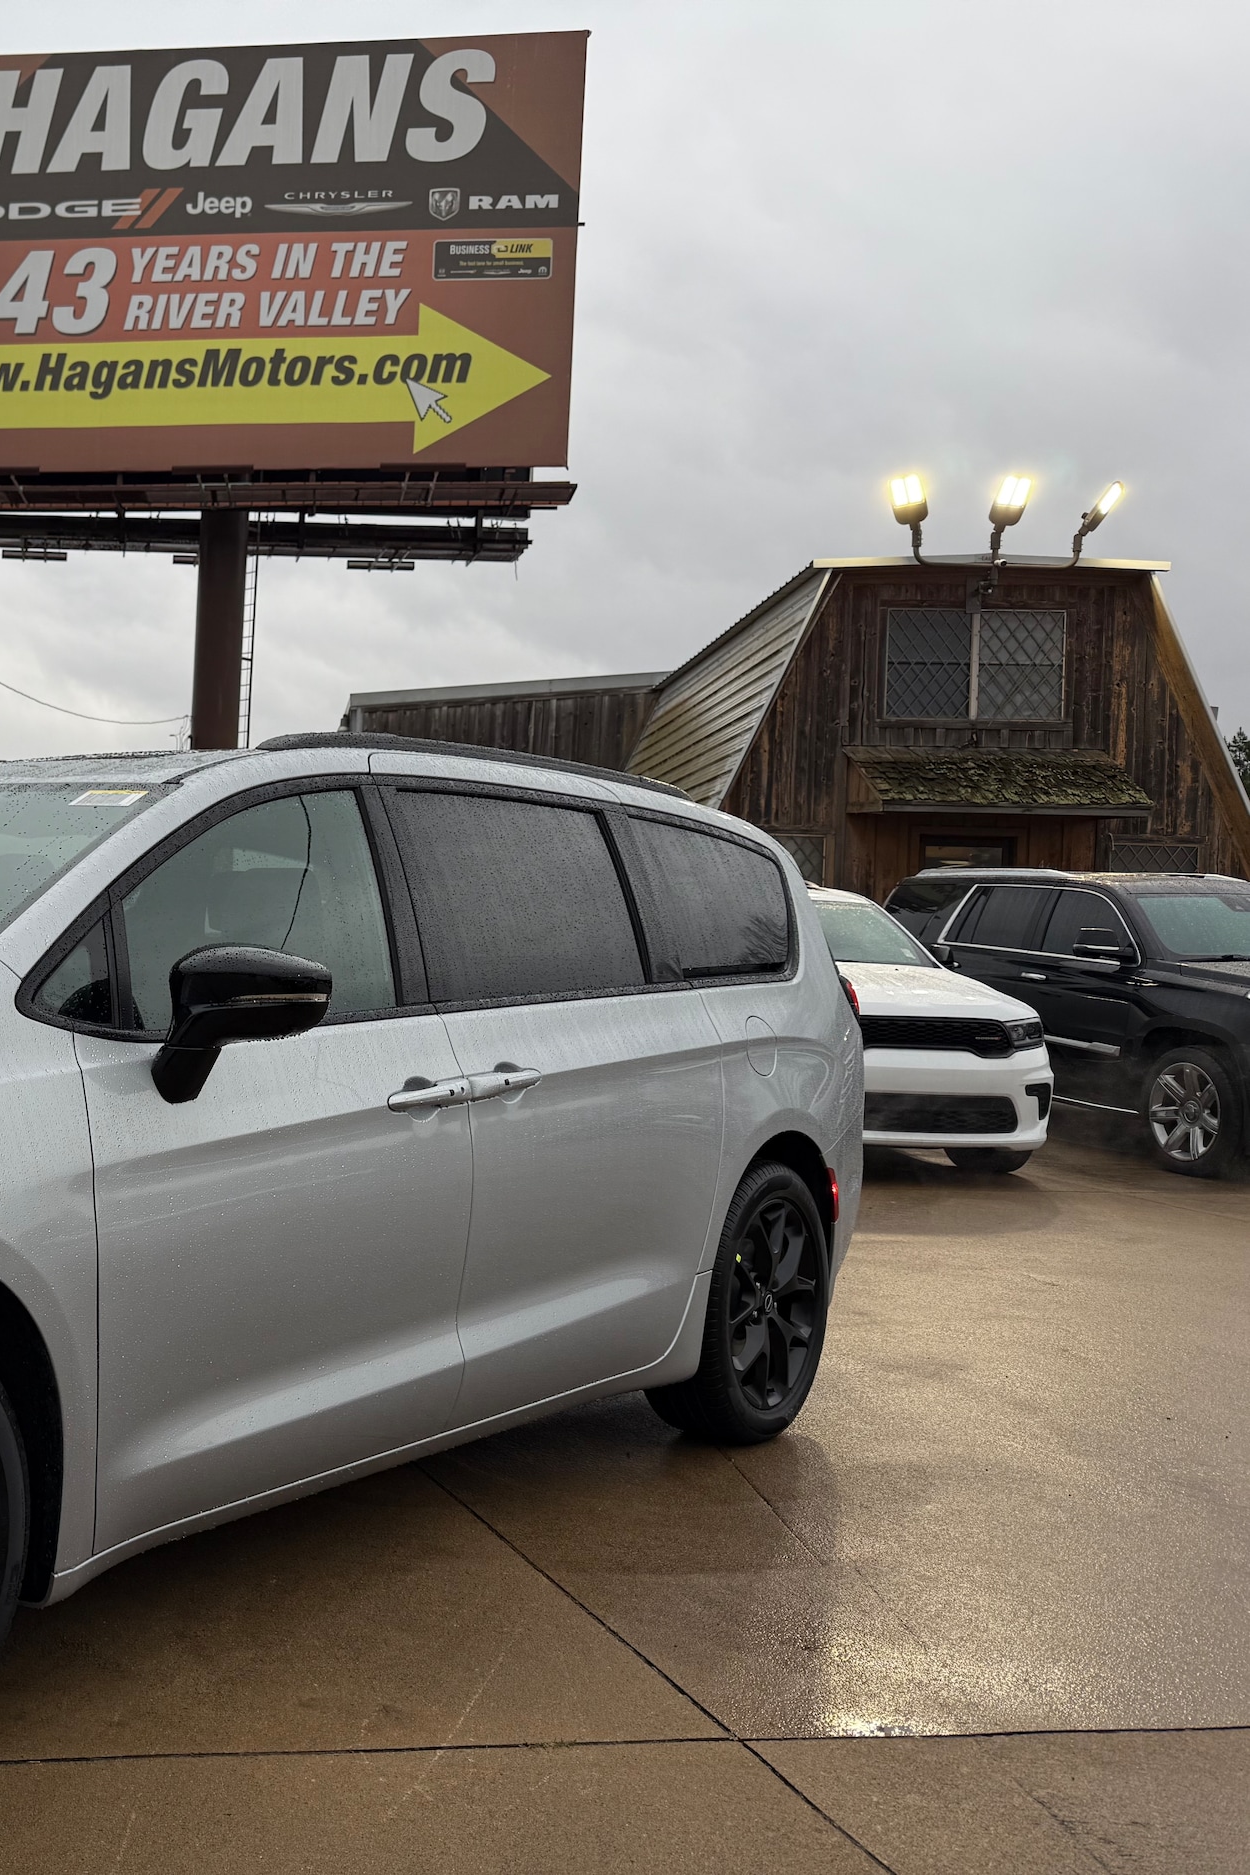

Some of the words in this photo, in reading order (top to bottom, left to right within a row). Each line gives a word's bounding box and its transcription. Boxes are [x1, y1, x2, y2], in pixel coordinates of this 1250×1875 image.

[185, 191, 253, 217] Jeep
[284, 190, 394, 200] CHRYSLER
[468, 194, 559, 210] RAM
[449, 244, 490, 255] BUSINESS
[509, 243, 534, 253] LINK
[130, 243, 260, 283] YEARS
[270, 242, 319, 279] IN
[330, 241, 409, 278] THE
[123, 291, 246, 331] RIVER
[258, 288, 412, 327] VALLEY
